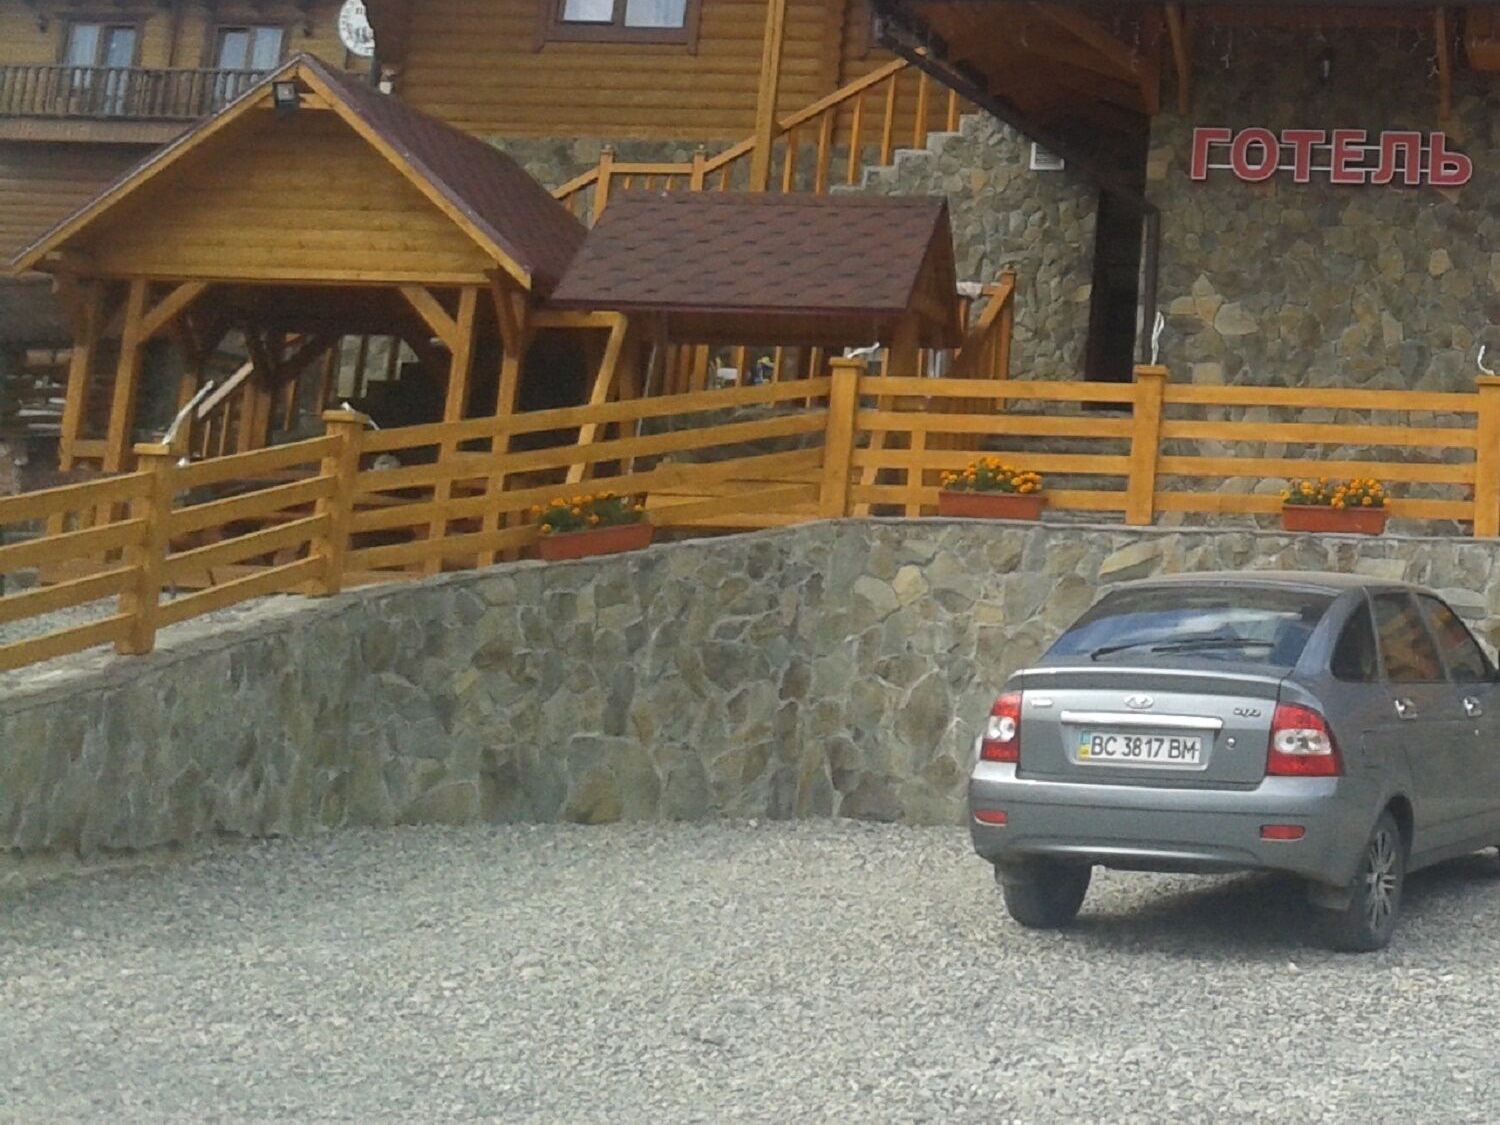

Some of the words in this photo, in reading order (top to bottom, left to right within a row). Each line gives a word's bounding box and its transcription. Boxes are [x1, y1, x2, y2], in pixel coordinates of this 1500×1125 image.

[1190, 127, 1474, 186] ГОТЕЛЬ
[1091, 735, 1117, 756] BC
[1121, 736, 1165, 758] 3817
